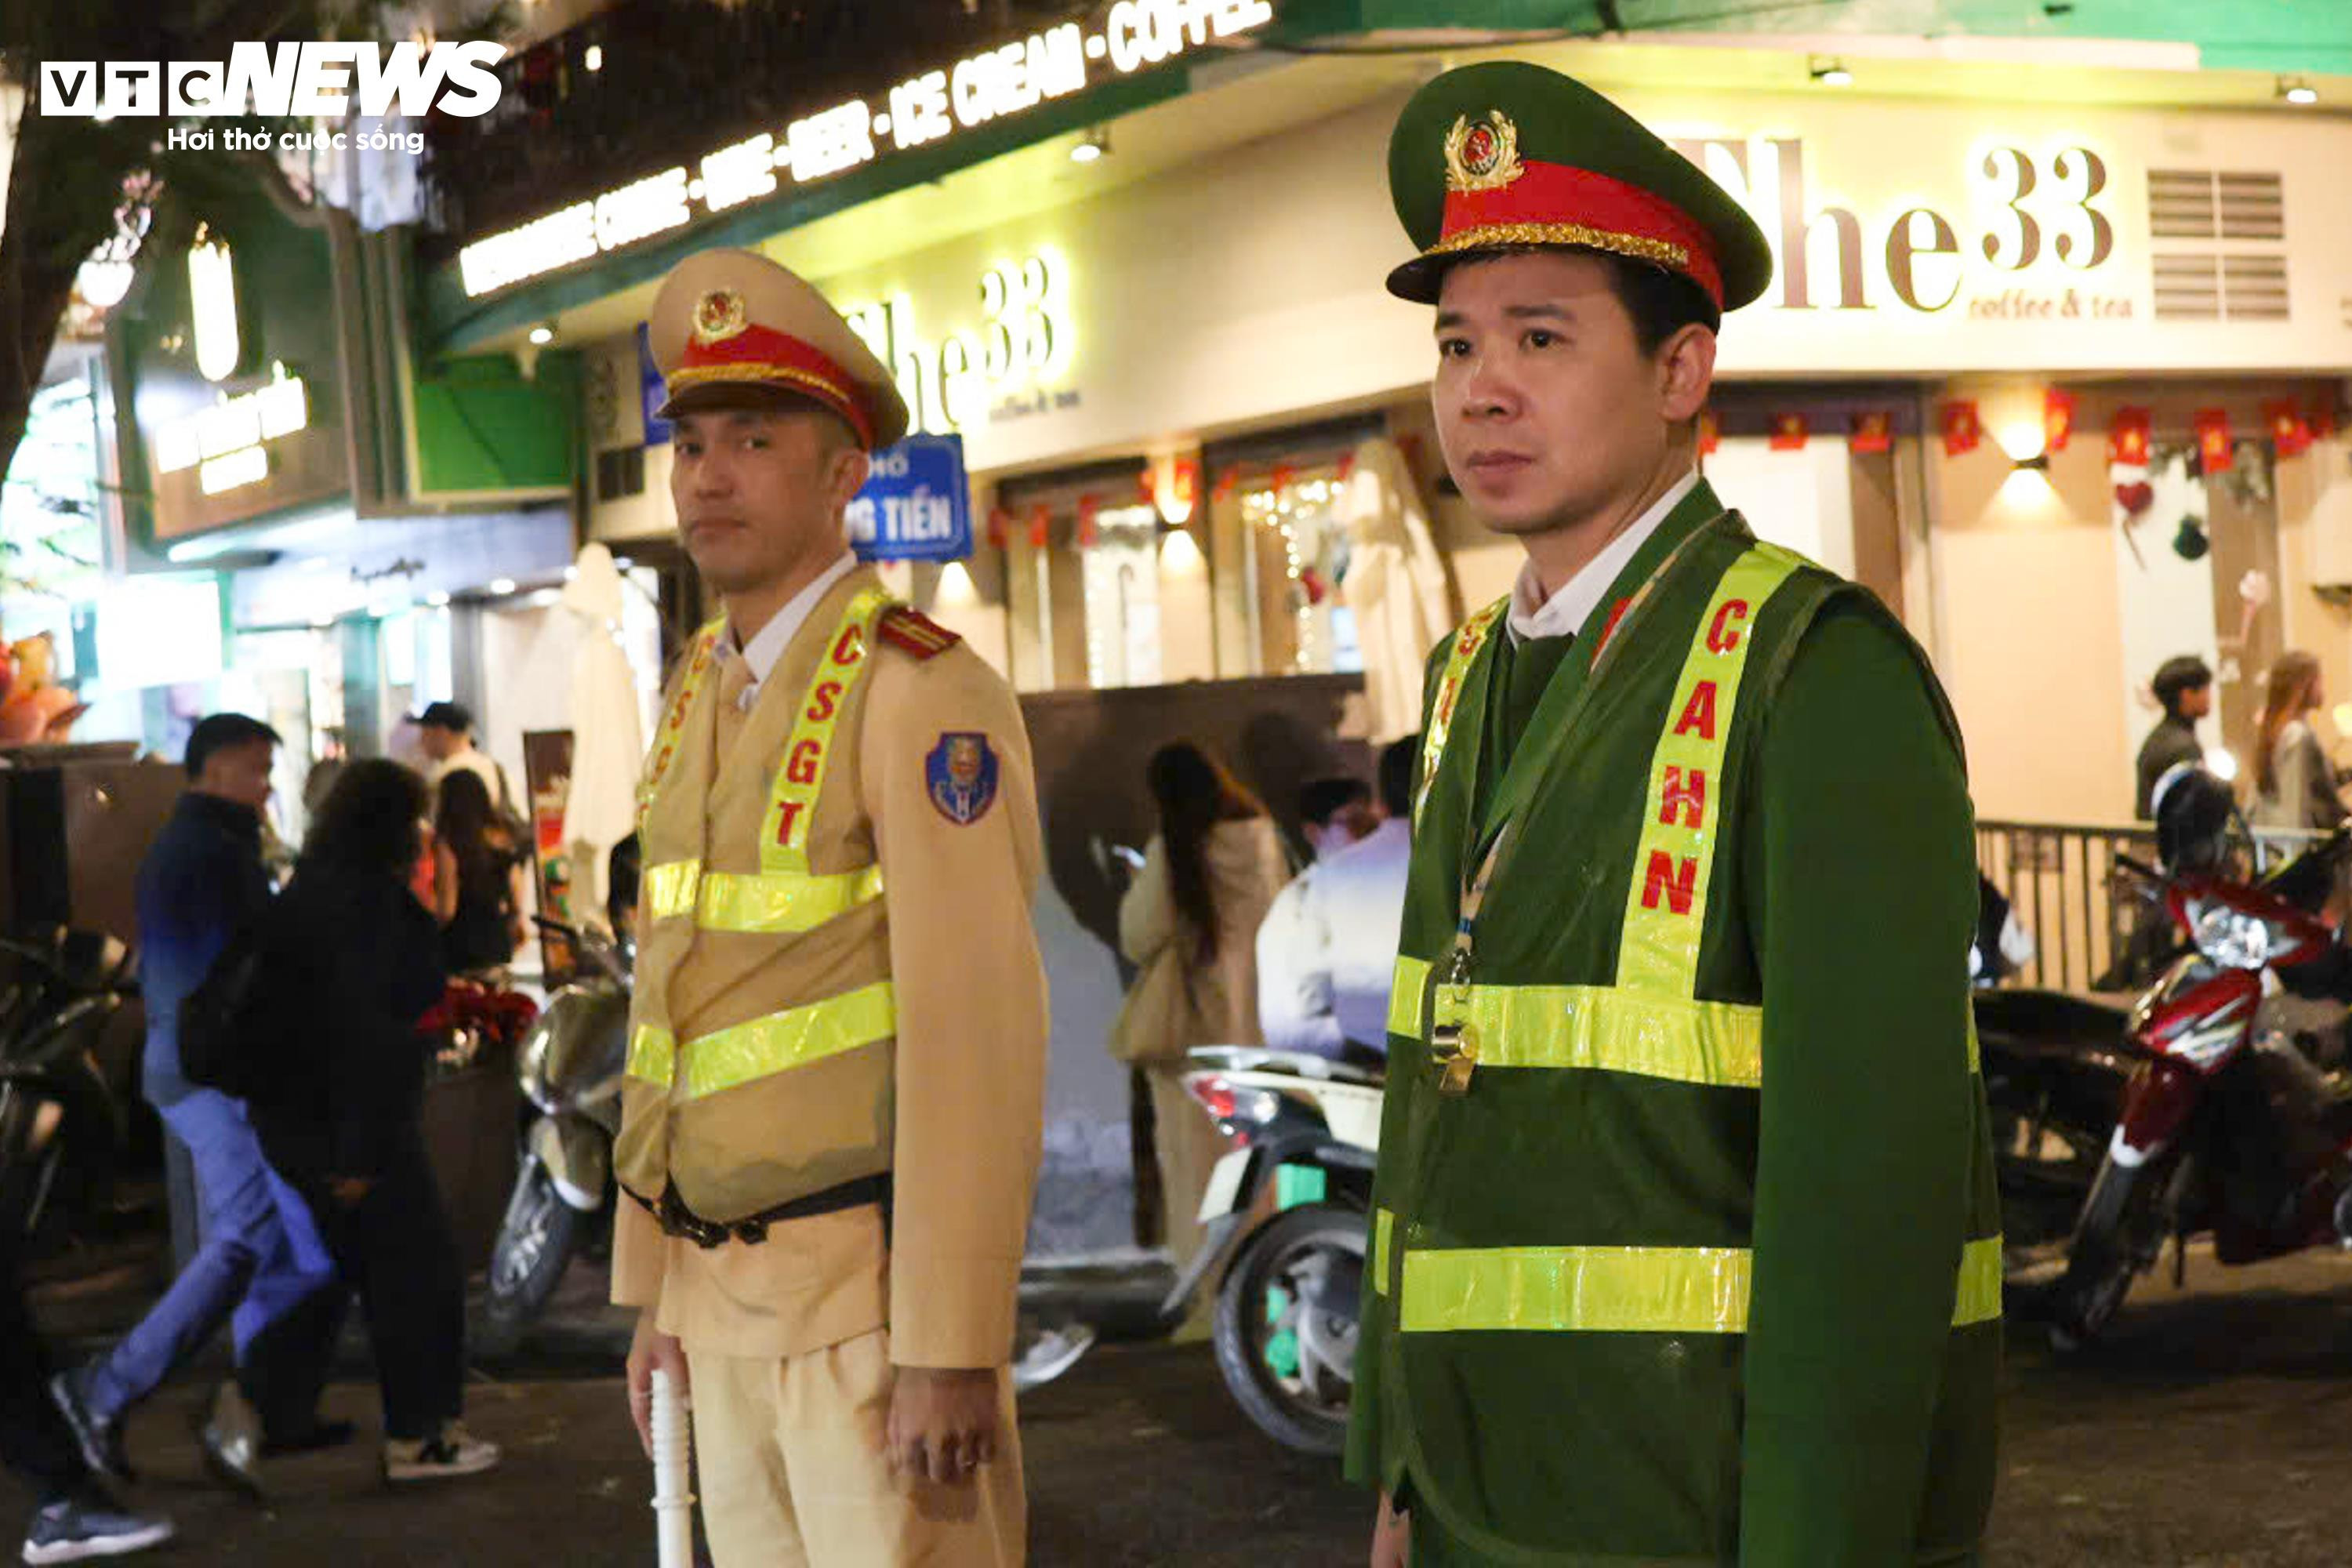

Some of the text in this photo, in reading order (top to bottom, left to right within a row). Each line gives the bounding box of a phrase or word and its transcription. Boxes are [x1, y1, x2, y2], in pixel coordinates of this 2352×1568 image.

[1107, 0, 1272, 73] COFF
[1981, 147, 2114, 270] 33
[777, 622, 866, 846] CSGT
[1640, 598, 1750, 916] CAHN
